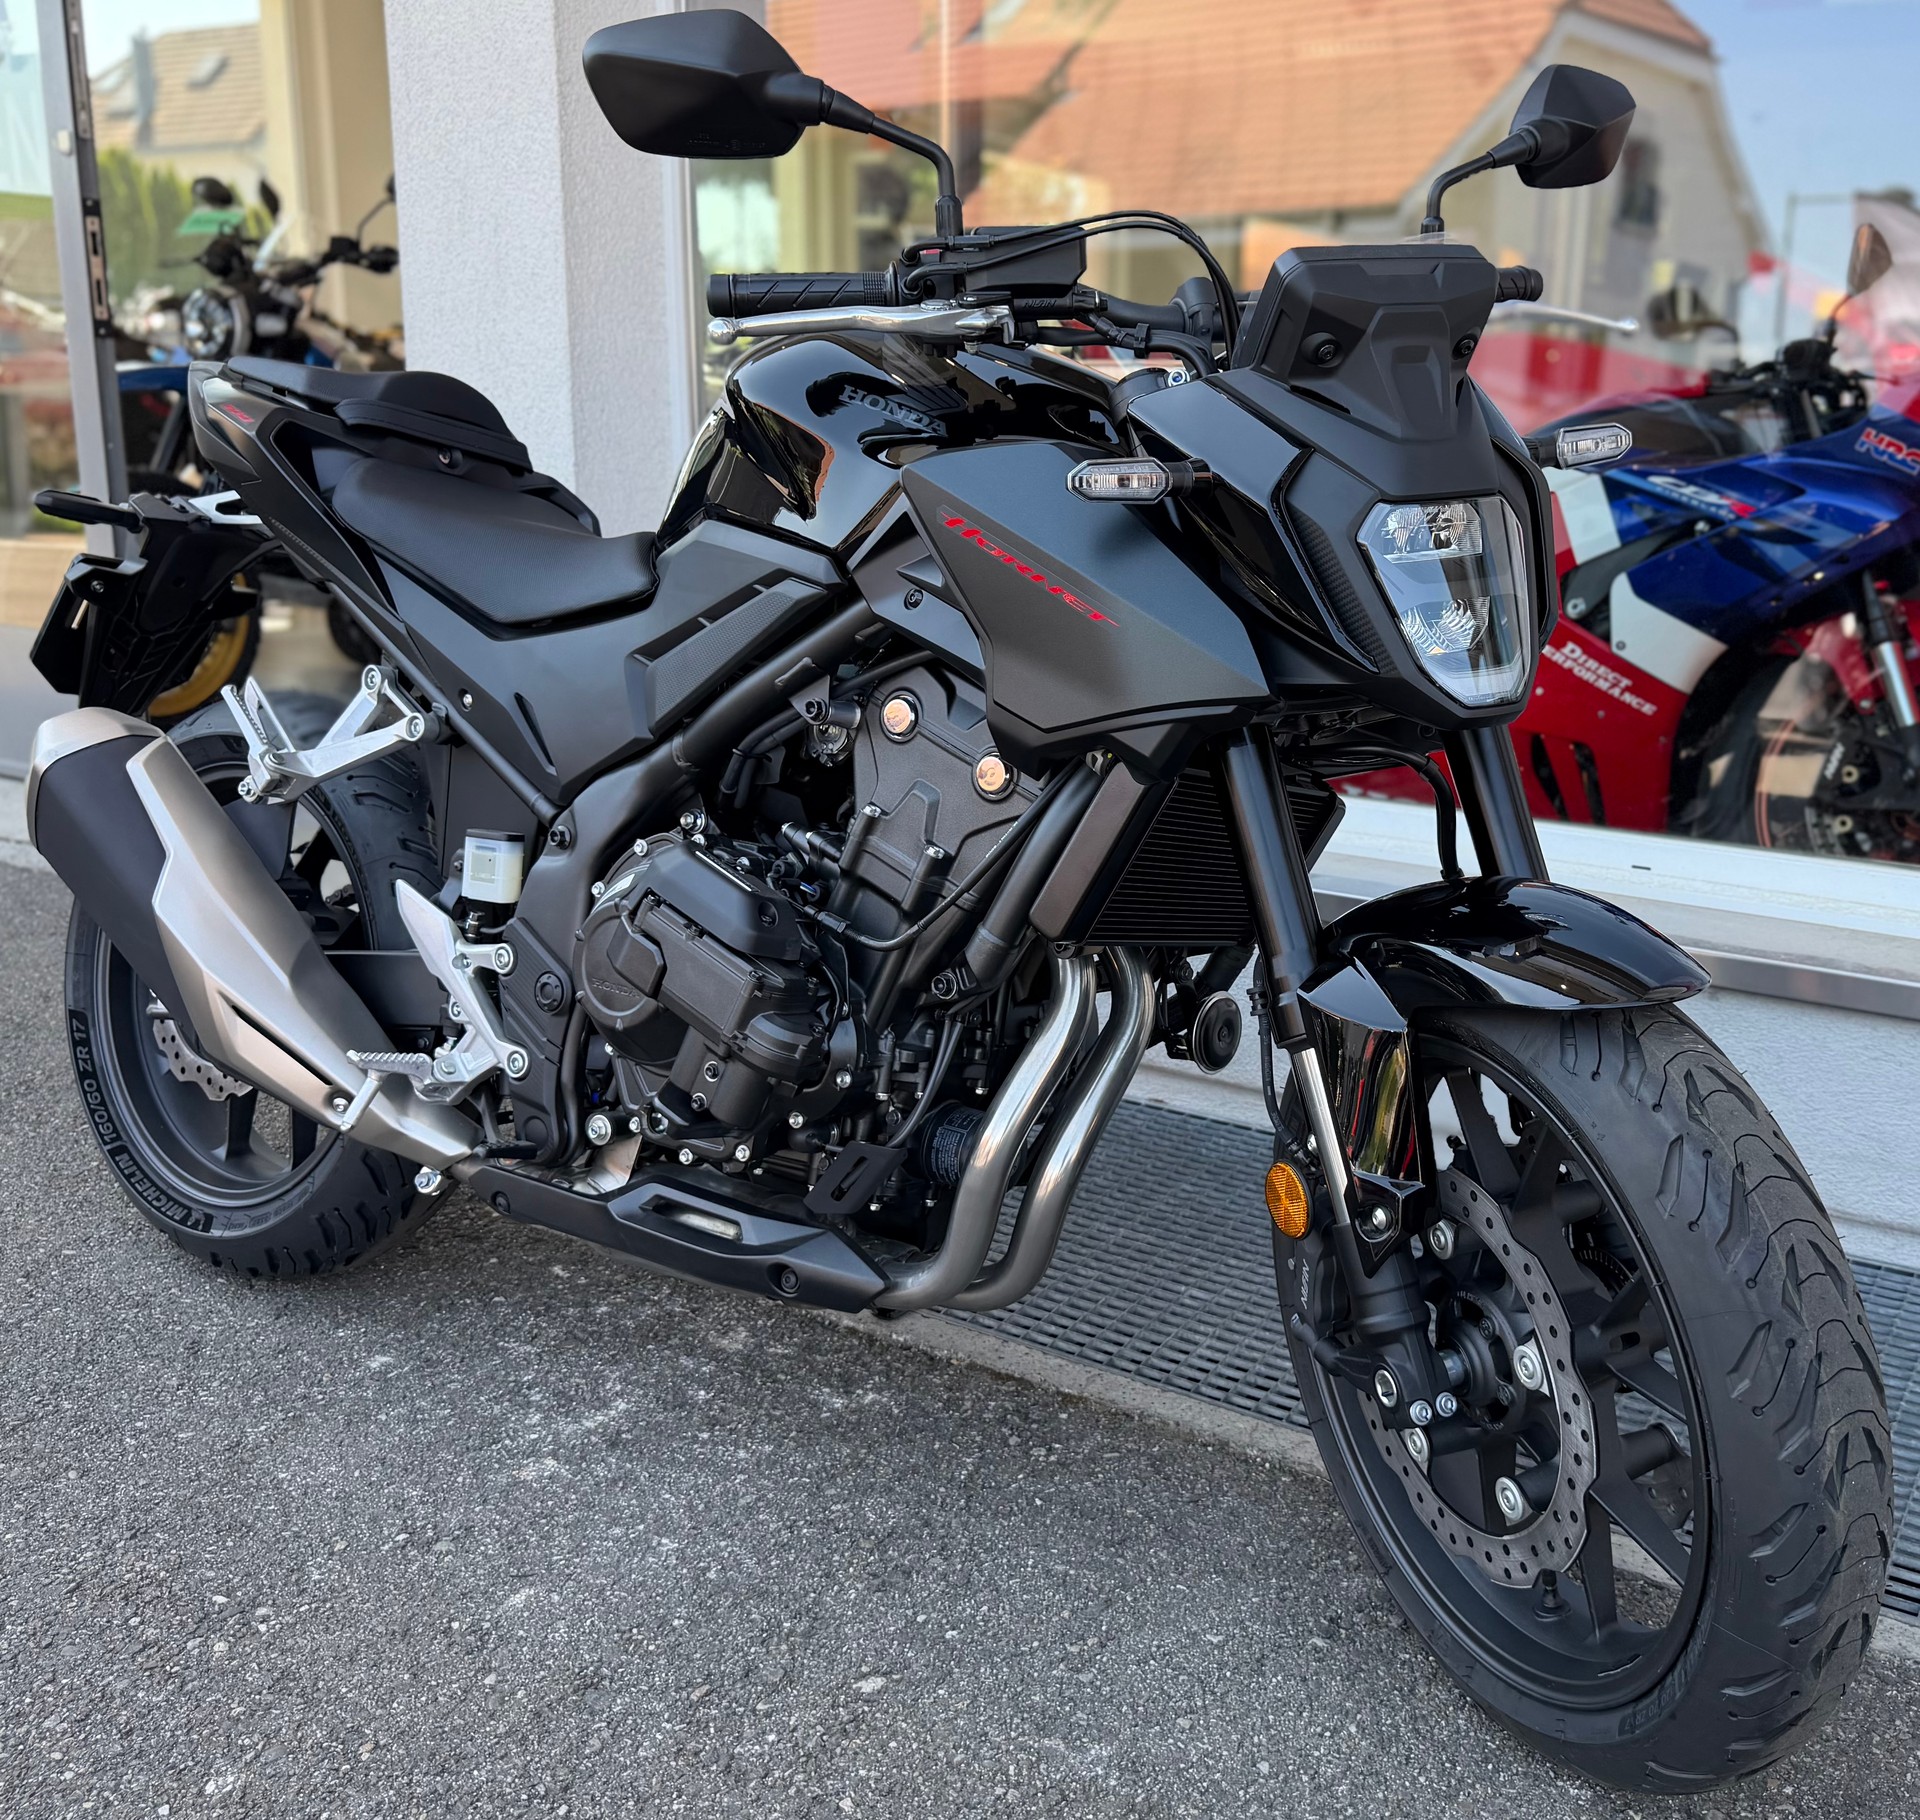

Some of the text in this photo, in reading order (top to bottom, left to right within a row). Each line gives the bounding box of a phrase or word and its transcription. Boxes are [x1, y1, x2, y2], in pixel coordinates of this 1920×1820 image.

[838, 384, 949, 437] HONDA
[1541, 644, 1659, 716] ERFORMANCE
[591, 977, 641, 999] HONDA
[71, 1017, 190, 1221] MICHELIN 160/60 ZR 17
